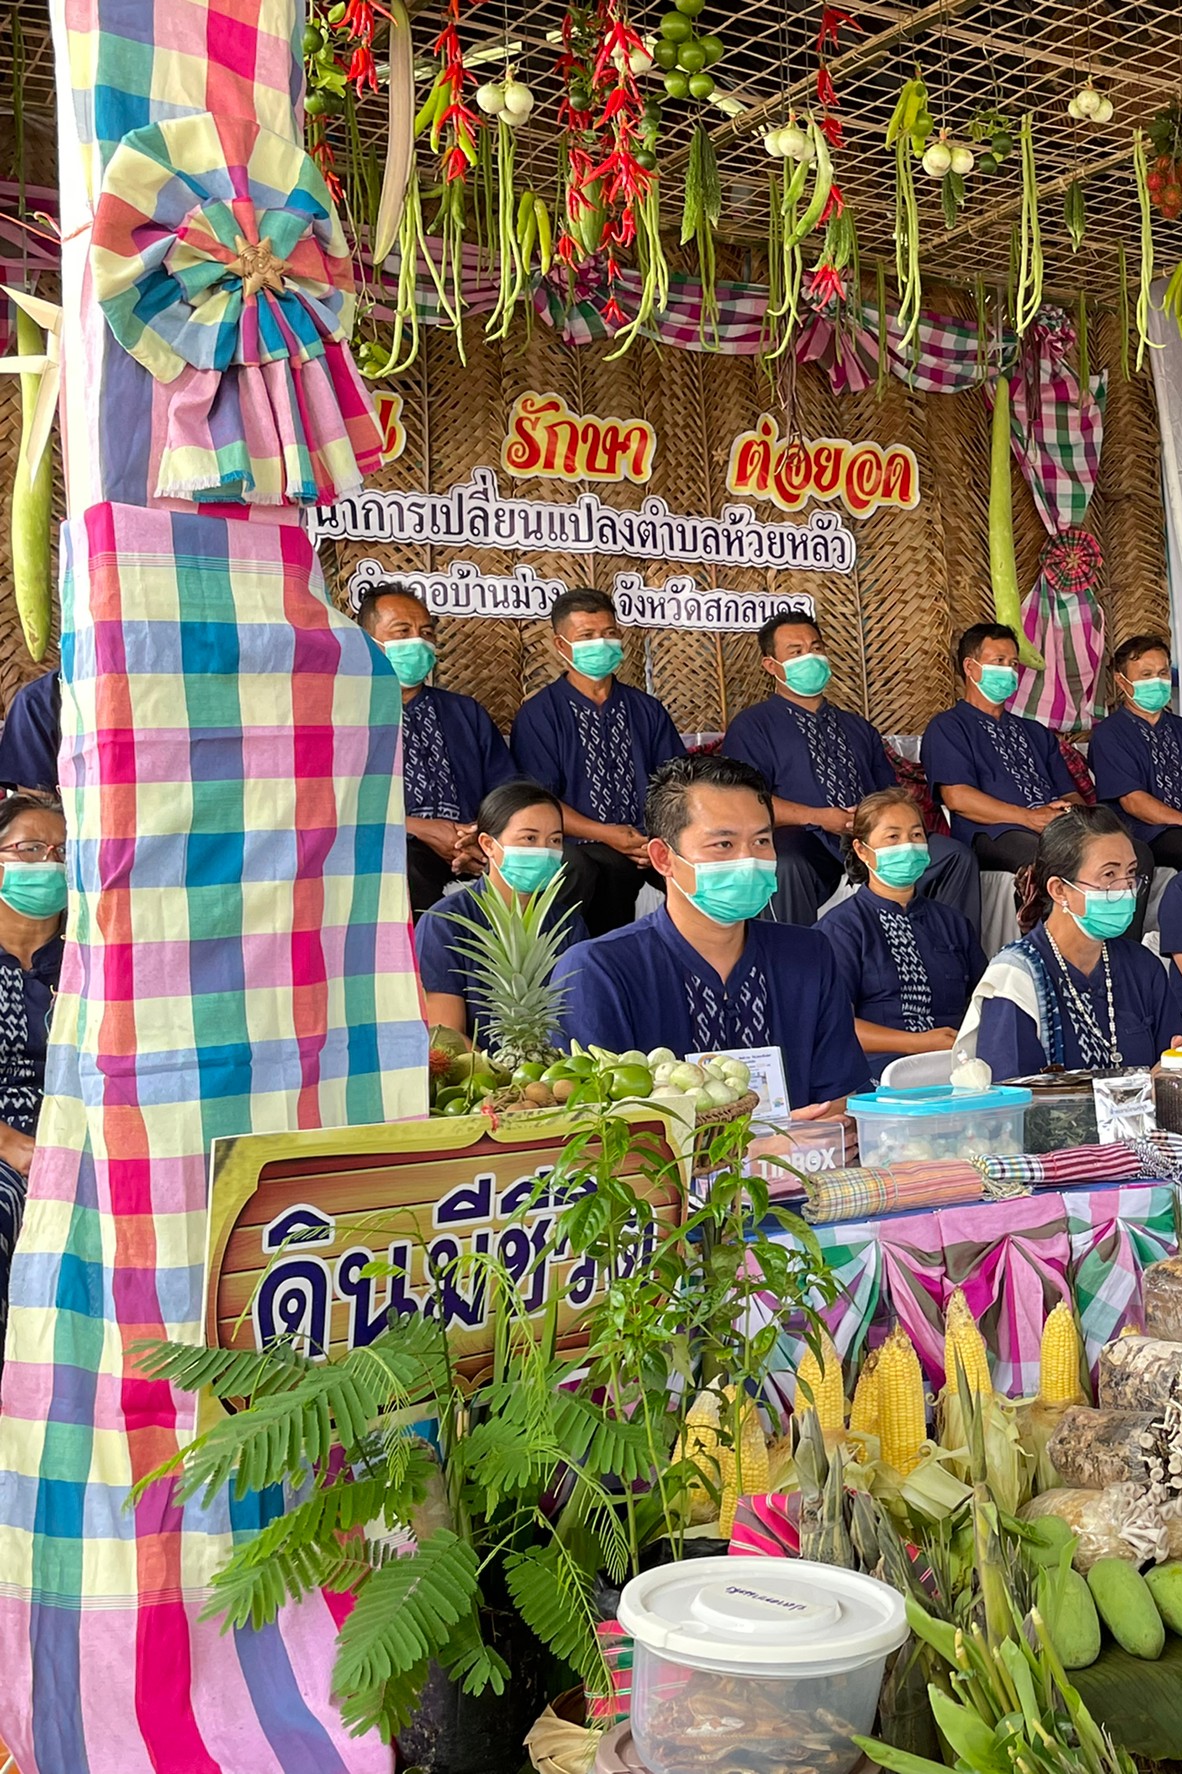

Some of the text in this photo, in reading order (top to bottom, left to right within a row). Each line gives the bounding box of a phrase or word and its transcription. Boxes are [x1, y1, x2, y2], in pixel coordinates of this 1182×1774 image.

[507, 398, 911, 509] รักษา ต่อยอด
